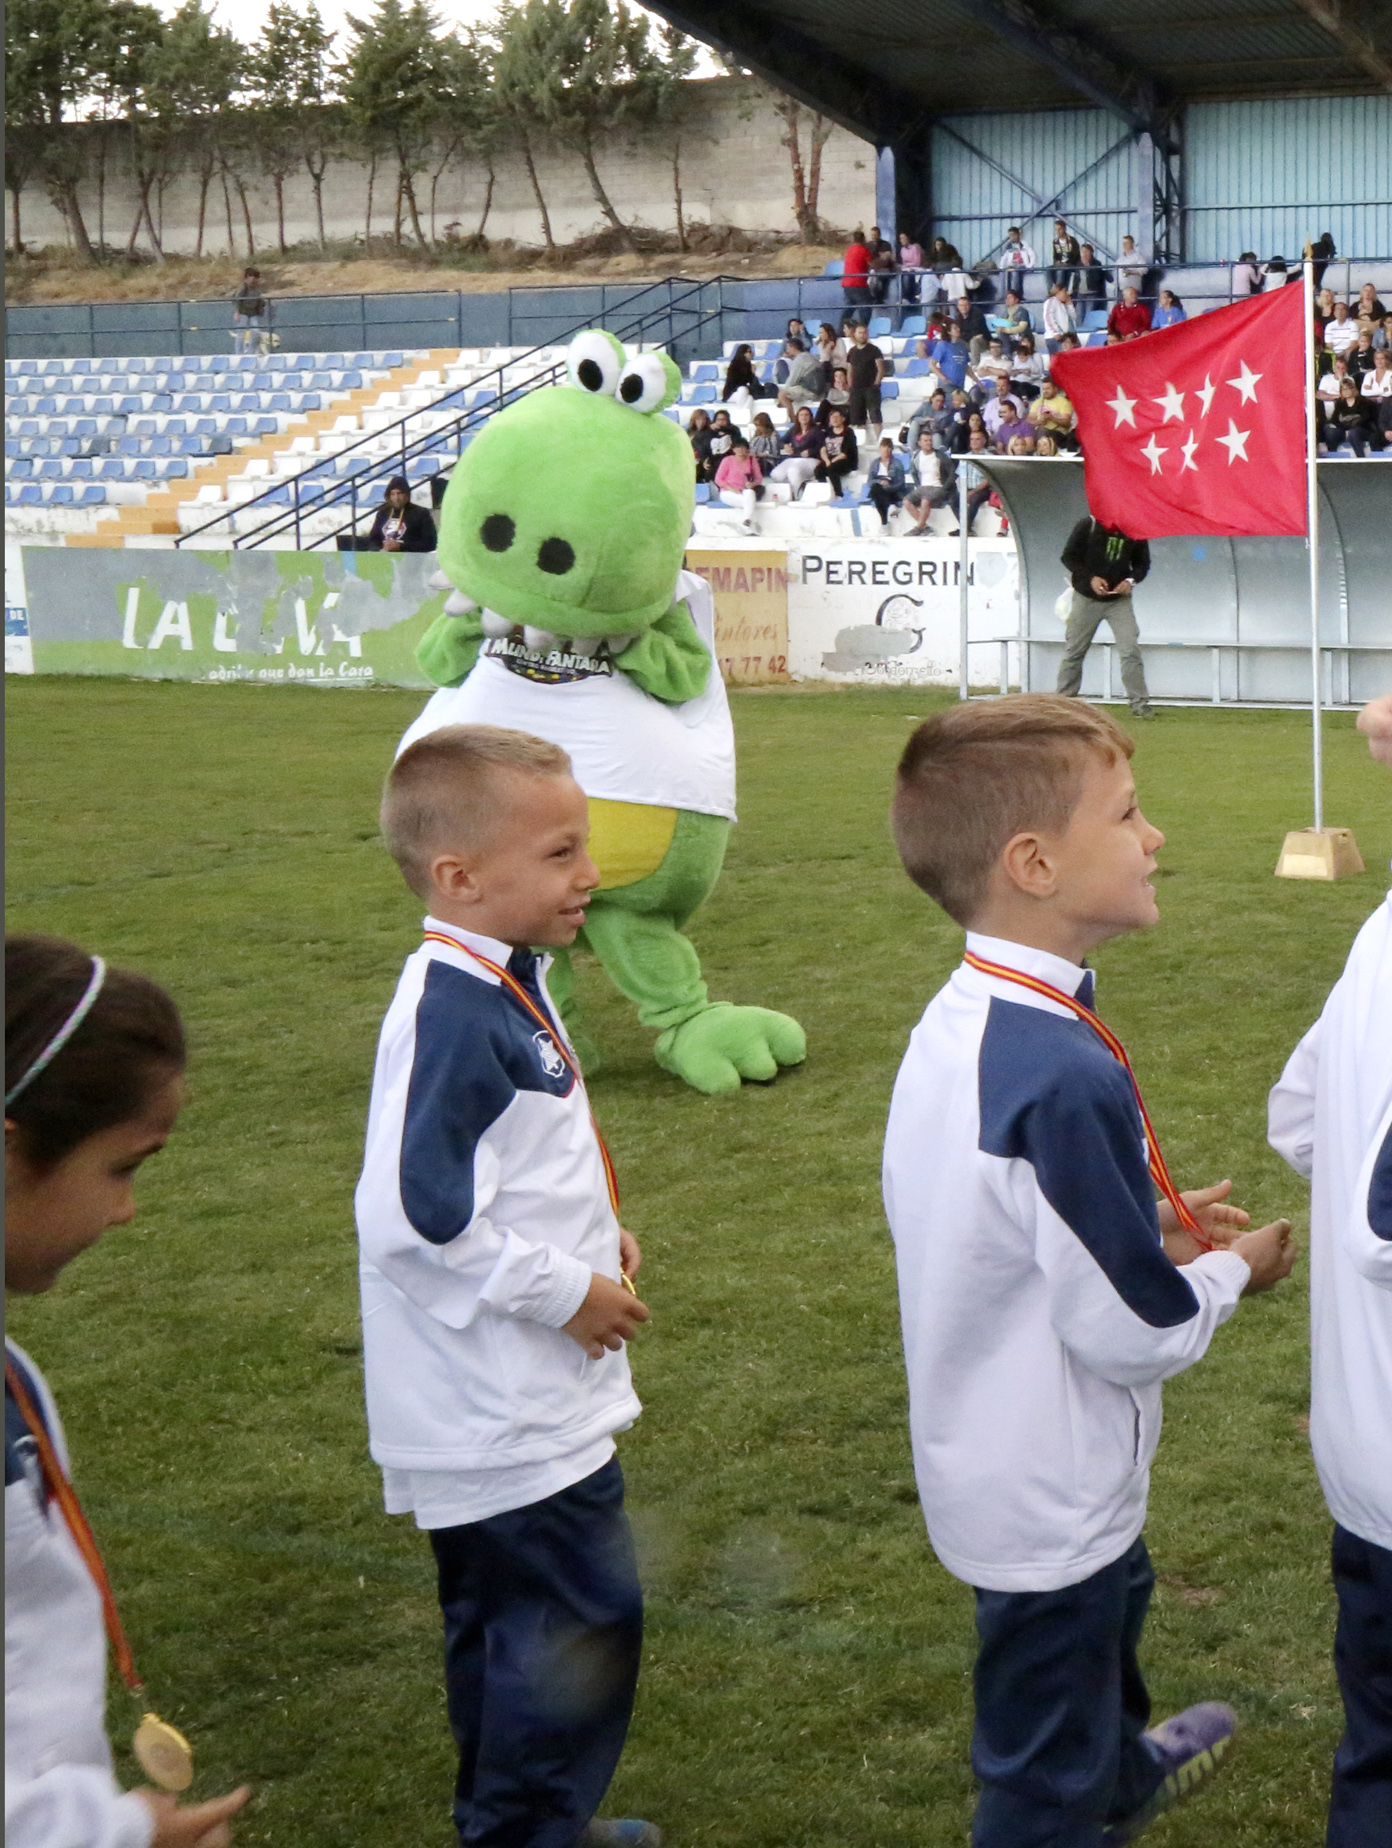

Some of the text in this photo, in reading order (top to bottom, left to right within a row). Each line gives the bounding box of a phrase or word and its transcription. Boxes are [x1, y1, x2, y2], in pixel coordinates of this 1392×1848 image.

[801, 555, 975, 586] PEREGRIN
[122, 586, 194, 650] LA
[339, 661, 373, 677] Cara
[741, 656, 762, 674] 77
[768, 655, 786, 674] 42
